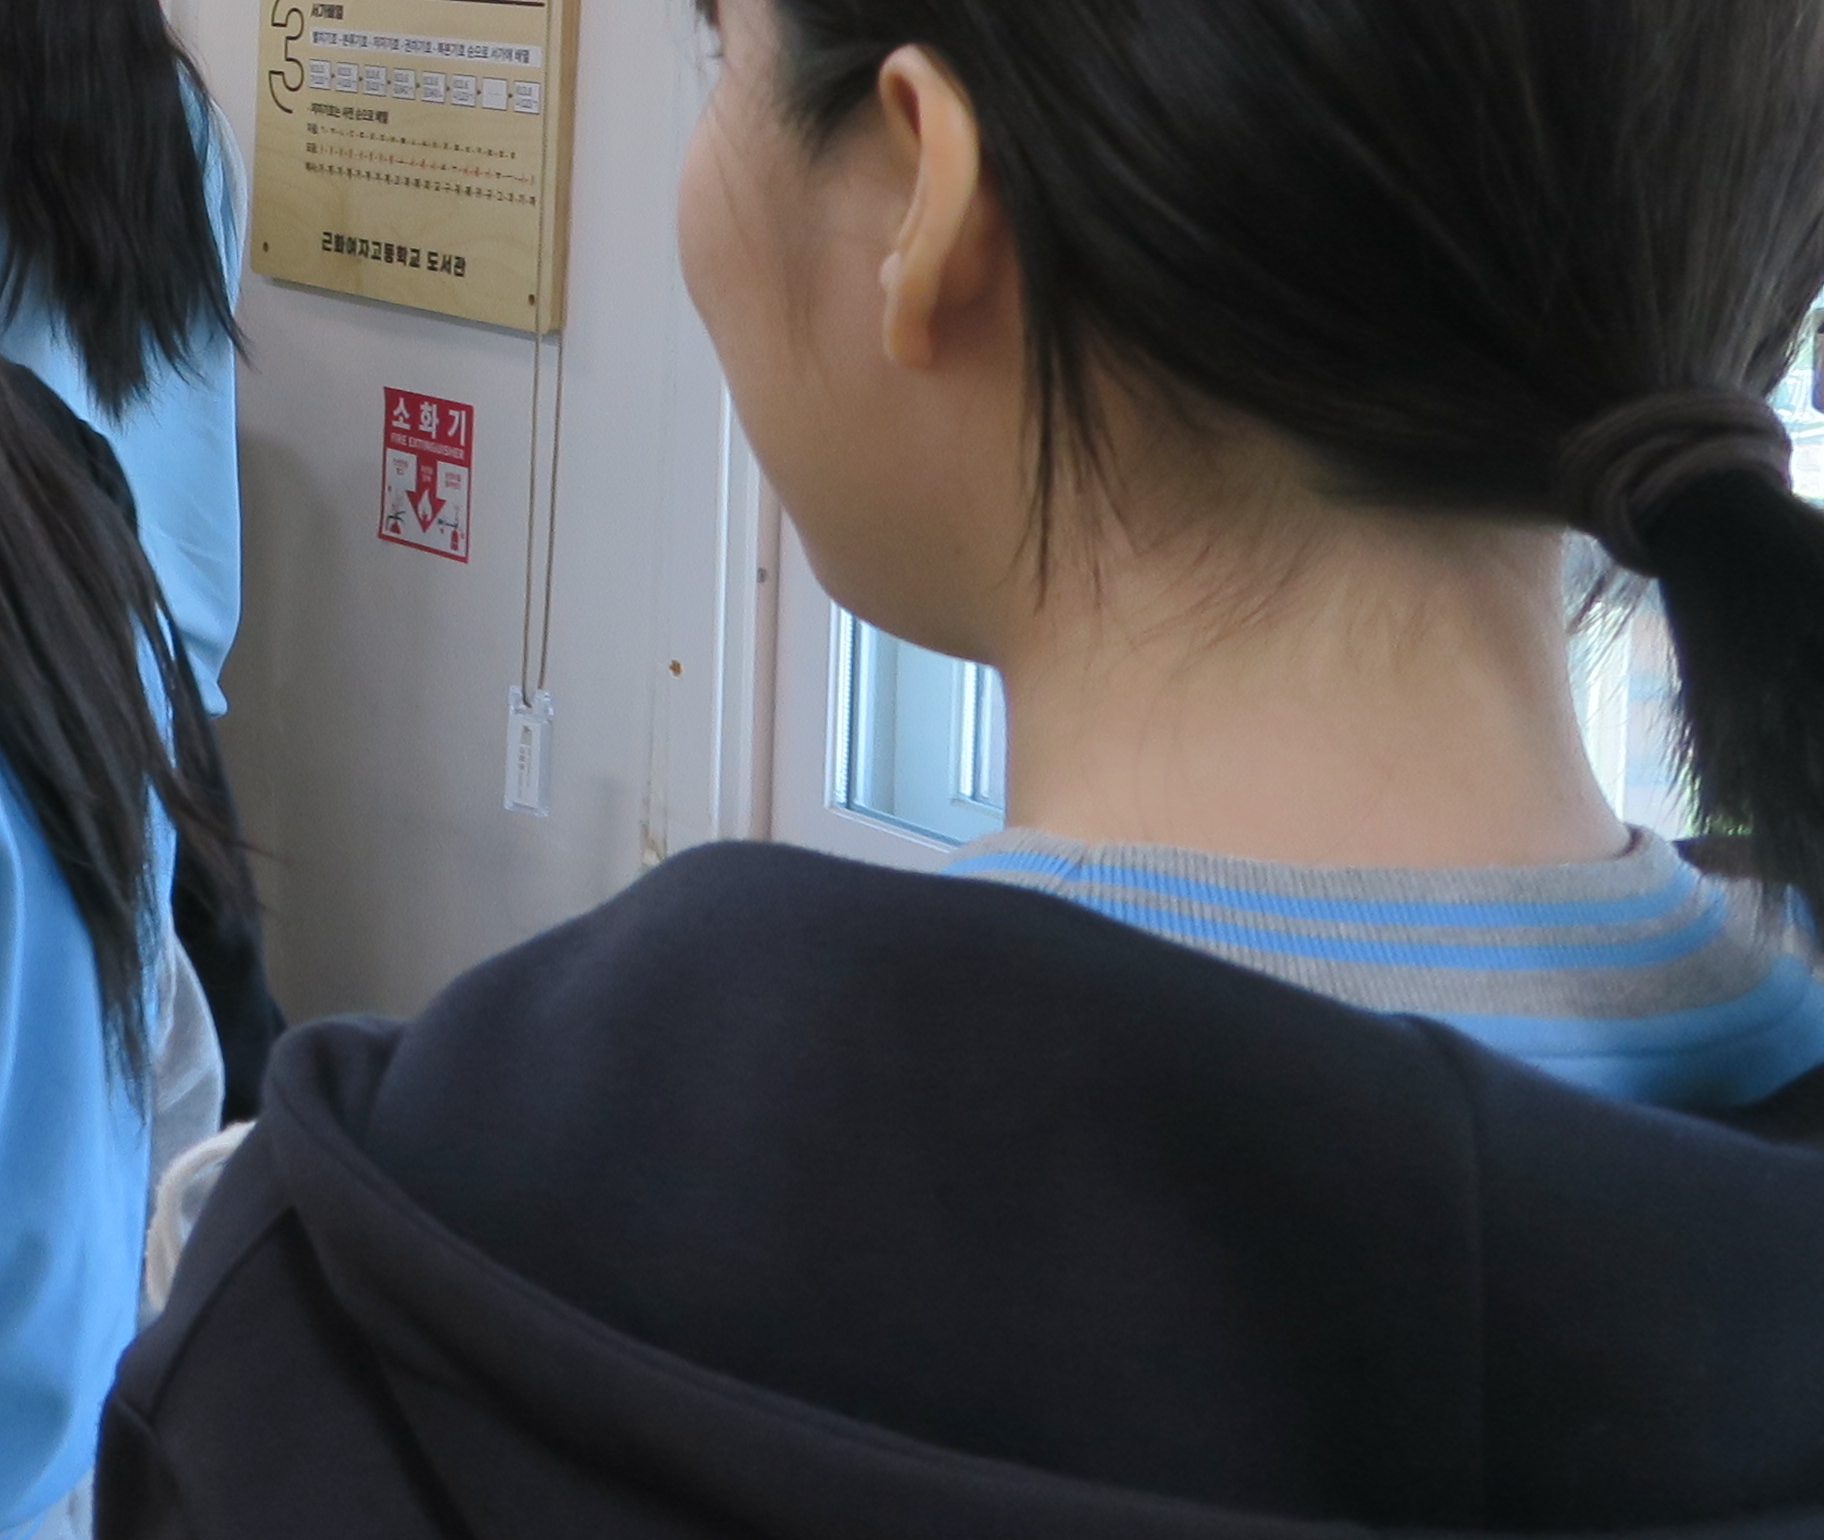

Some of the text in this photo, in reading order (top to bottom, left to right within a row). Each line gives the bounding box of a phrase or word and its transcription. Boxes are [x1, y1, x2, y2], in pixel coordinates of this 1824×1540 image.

[321, 230, 467, 278] 근화여자고등학교 도서관
[390, 433, 465, 460] FIRE EXTINGUISHER
